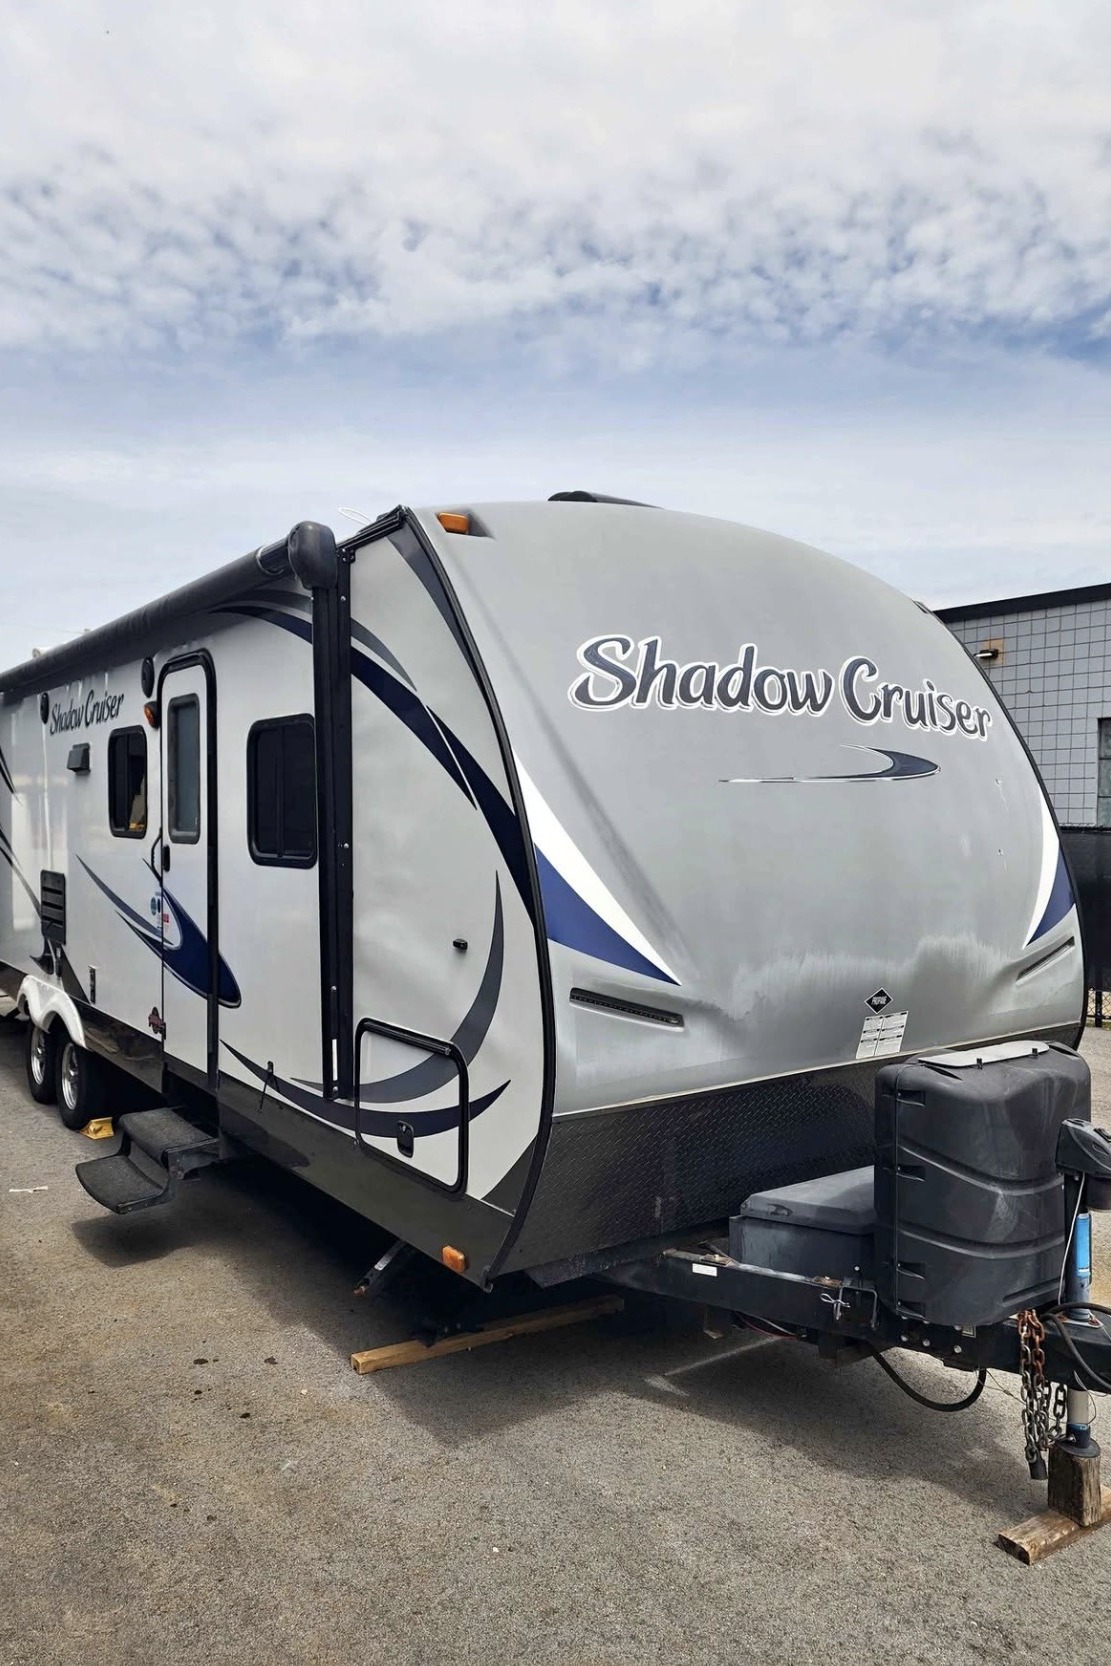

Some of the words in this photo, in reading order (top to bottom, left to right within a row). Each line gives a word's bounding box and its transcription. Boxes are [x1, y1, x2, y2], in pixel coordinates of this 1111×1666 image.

[50, 699, 84, 735] Shadow
[85, 689, 124, 727] Cruiser
[568, 634, 834, 716] Shadow
[840, 656, 991, 740] Cruiser
